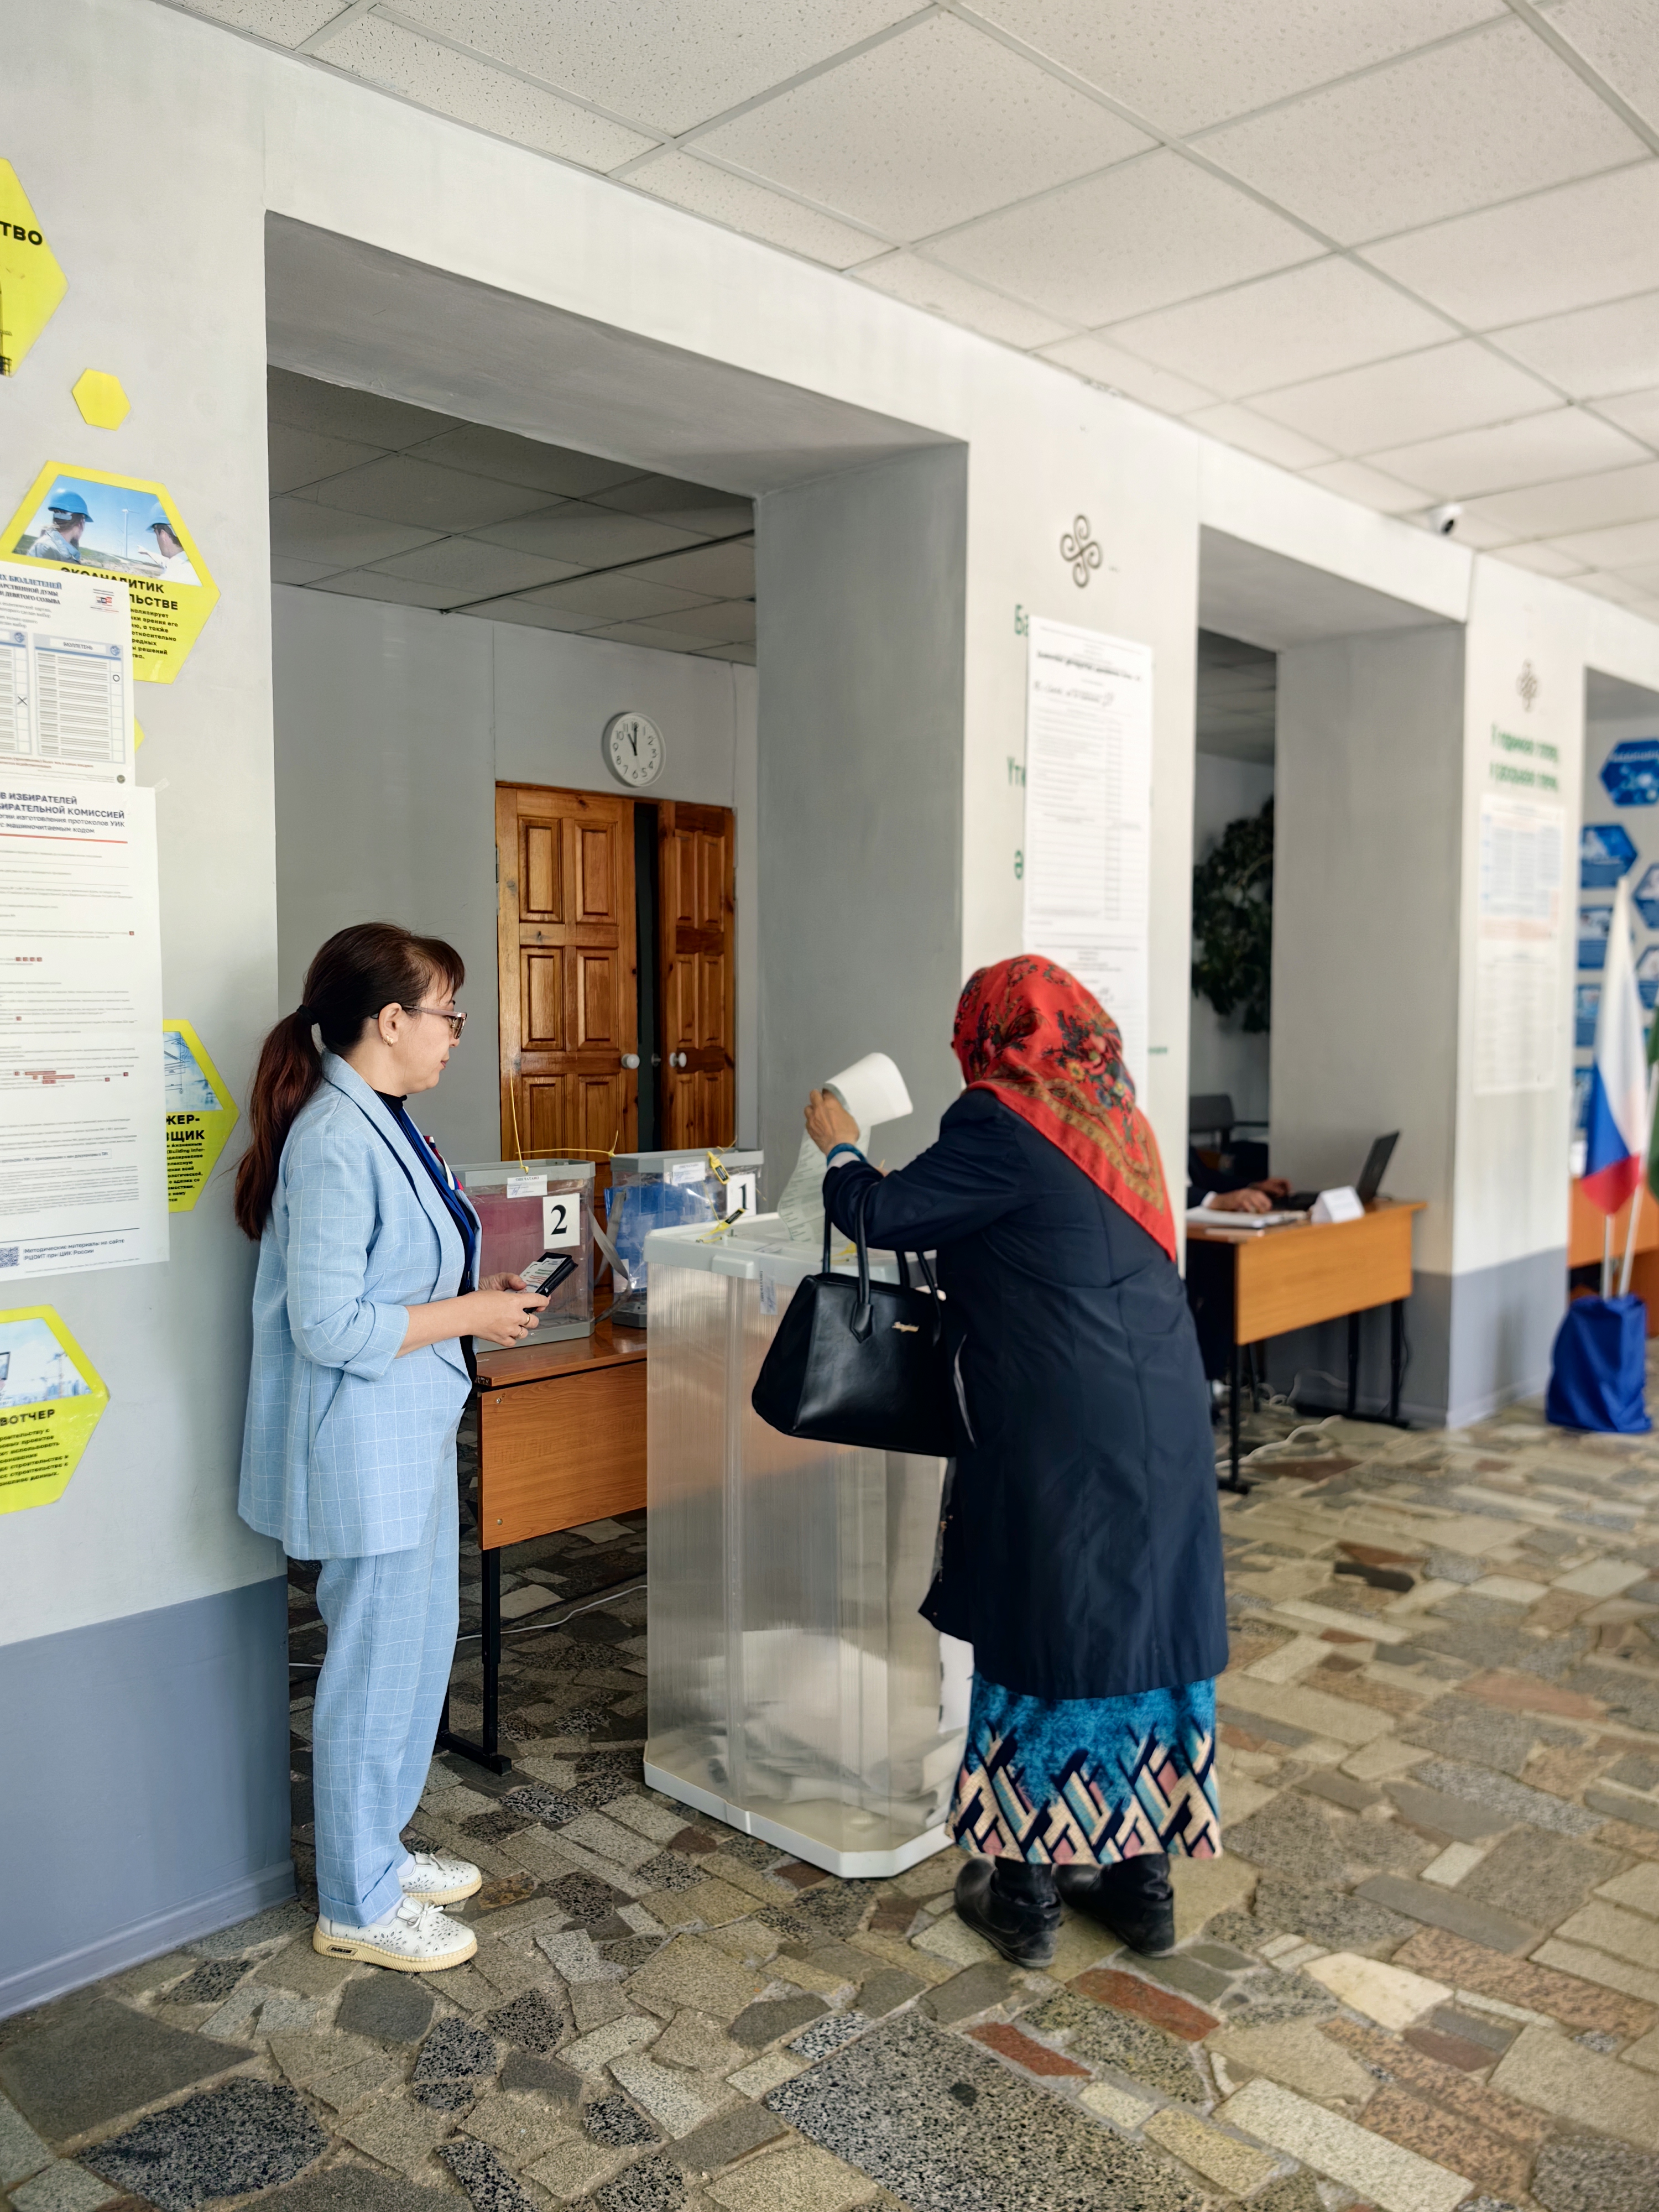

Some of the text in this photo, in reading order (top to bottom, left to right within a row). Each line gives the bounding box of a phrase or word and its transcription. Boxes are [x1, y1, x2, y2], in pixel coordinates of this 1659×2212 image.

[0, 220, 43, 246] ТВО
[617, 731, 624, 740] 10
[648, 736, 655, 745] 2
[613, 742, 619, 752] 9
[651, 748, 658, 758] 3
[616, 755, 622, 765] 8
[649, 760, 654, 769] 4
[623, 765, 628, 776] 7
[633, 770, 638, 779] 6
[641, 768, 647, 777] 5
[9, 792, 77, 805] ИЗБИРАТЕЛЕЙ
[67, 808, 124, 818] КОМИССИЕЙ
[739, 1183, 749, 1209] 1
[550, 1204, 568, 1235] 2
